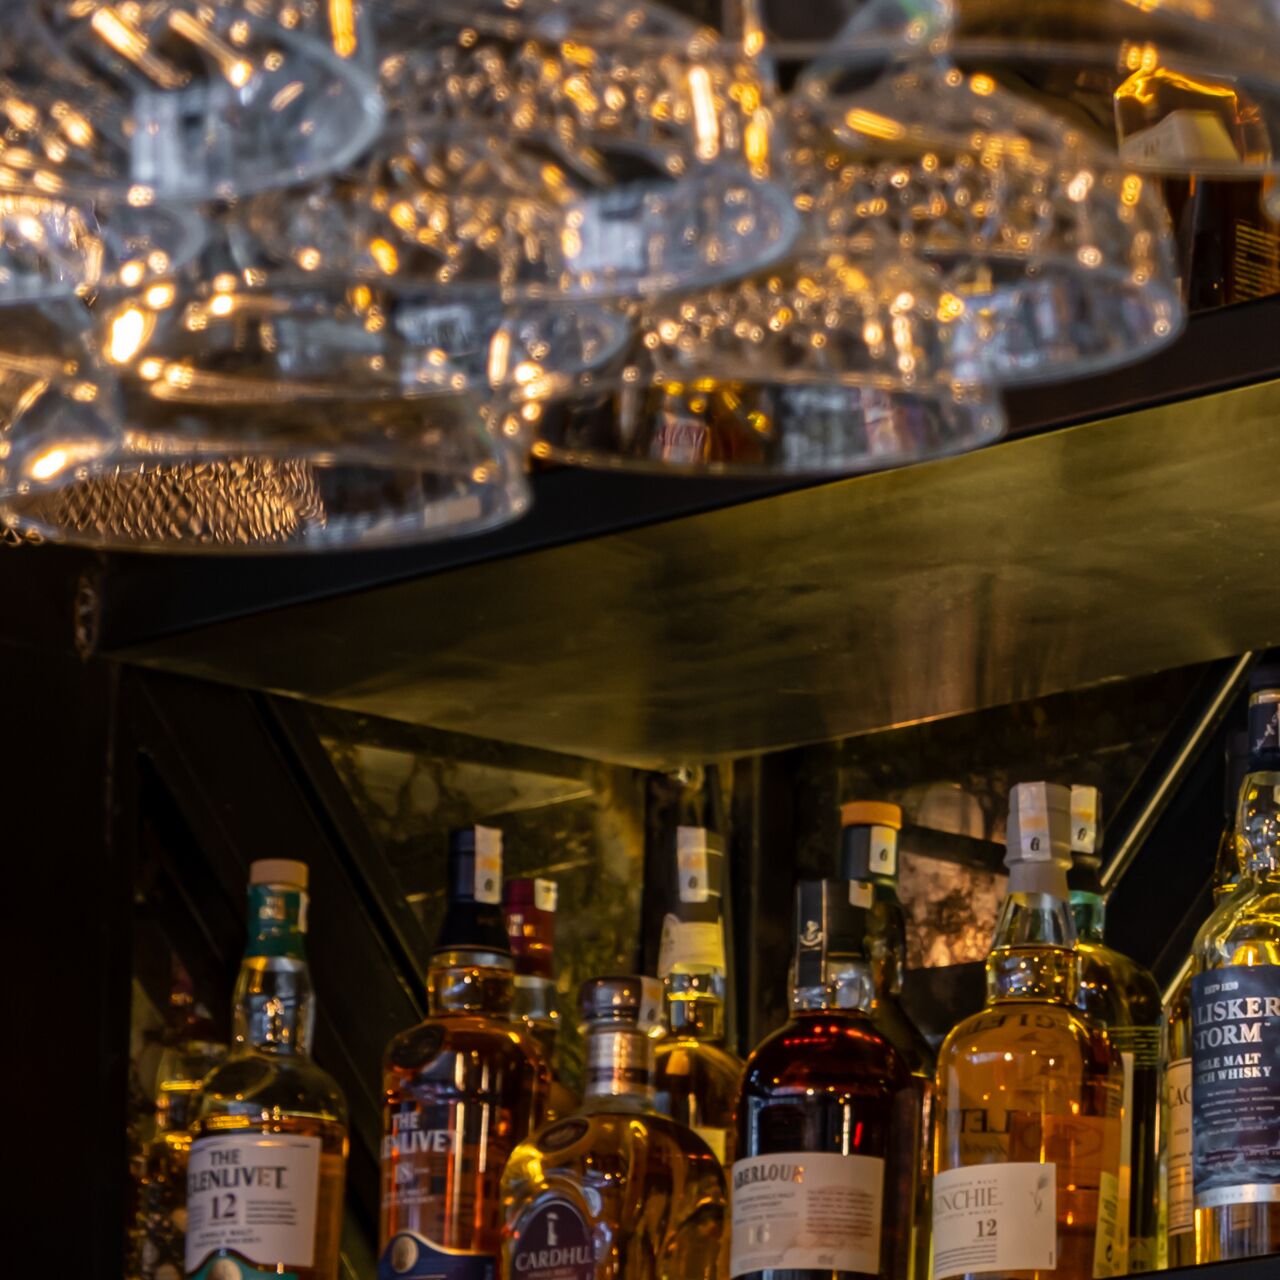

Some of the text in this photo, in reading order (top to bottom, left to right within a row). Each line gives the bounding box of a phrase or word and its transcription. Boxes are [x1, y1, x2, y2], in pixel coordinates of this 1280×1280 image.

[1223, 1052, 1262, 1067] MALT
[1217, 1065, 1273, 1081] WHISKY
[209, 1148, 241, 1168] THE
[210, 1193, 238, 1220] 12
[976, 1217, 998, 1238] 12
[514, 1245, 590, 1272] CARDHU
